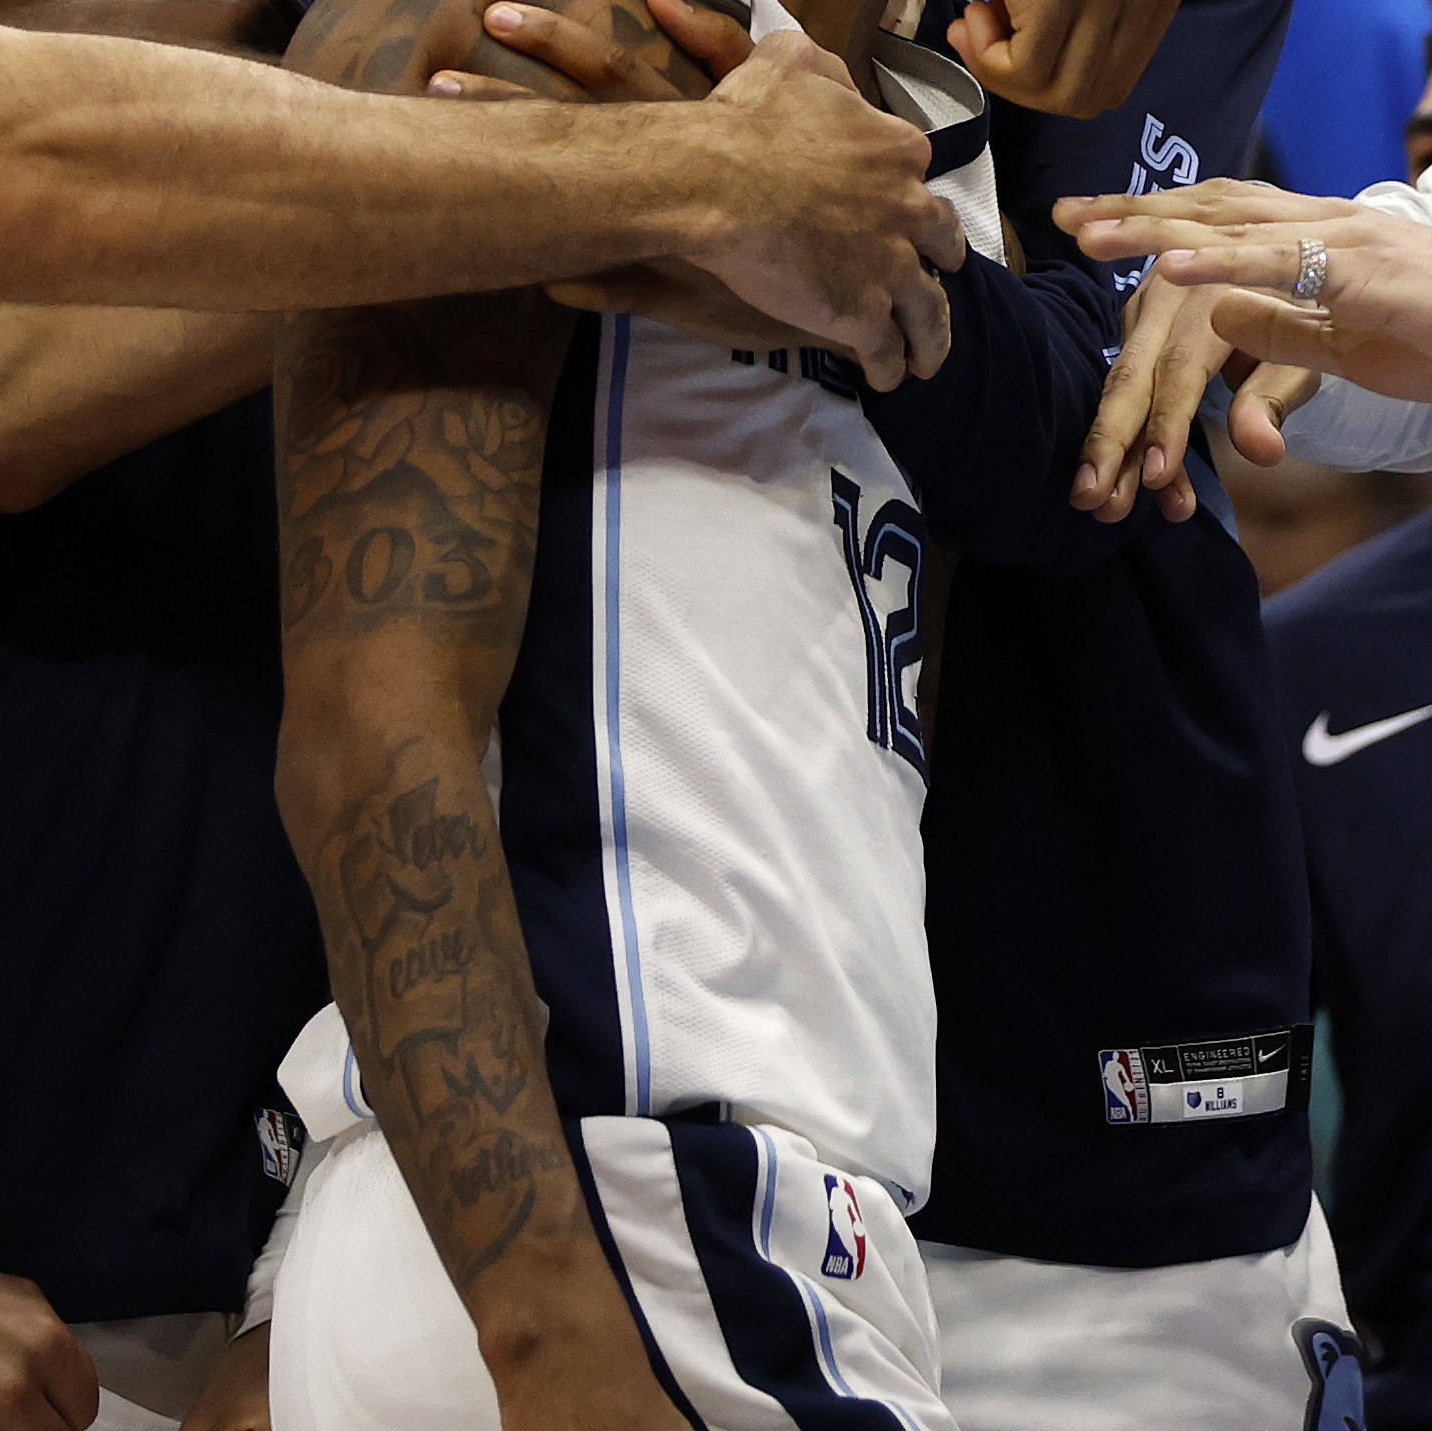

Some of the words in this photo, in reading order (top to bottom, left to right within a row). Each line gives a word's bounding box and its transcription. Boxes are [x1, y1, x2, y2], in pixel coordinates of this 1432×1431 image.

[830, 466, 928, 789] 12
[1183, 1046, 1251, 1062] ENGINEERED
[1151, 1058, 1175, 1074] XL
[825, 1254, 850, 1275] NBA
